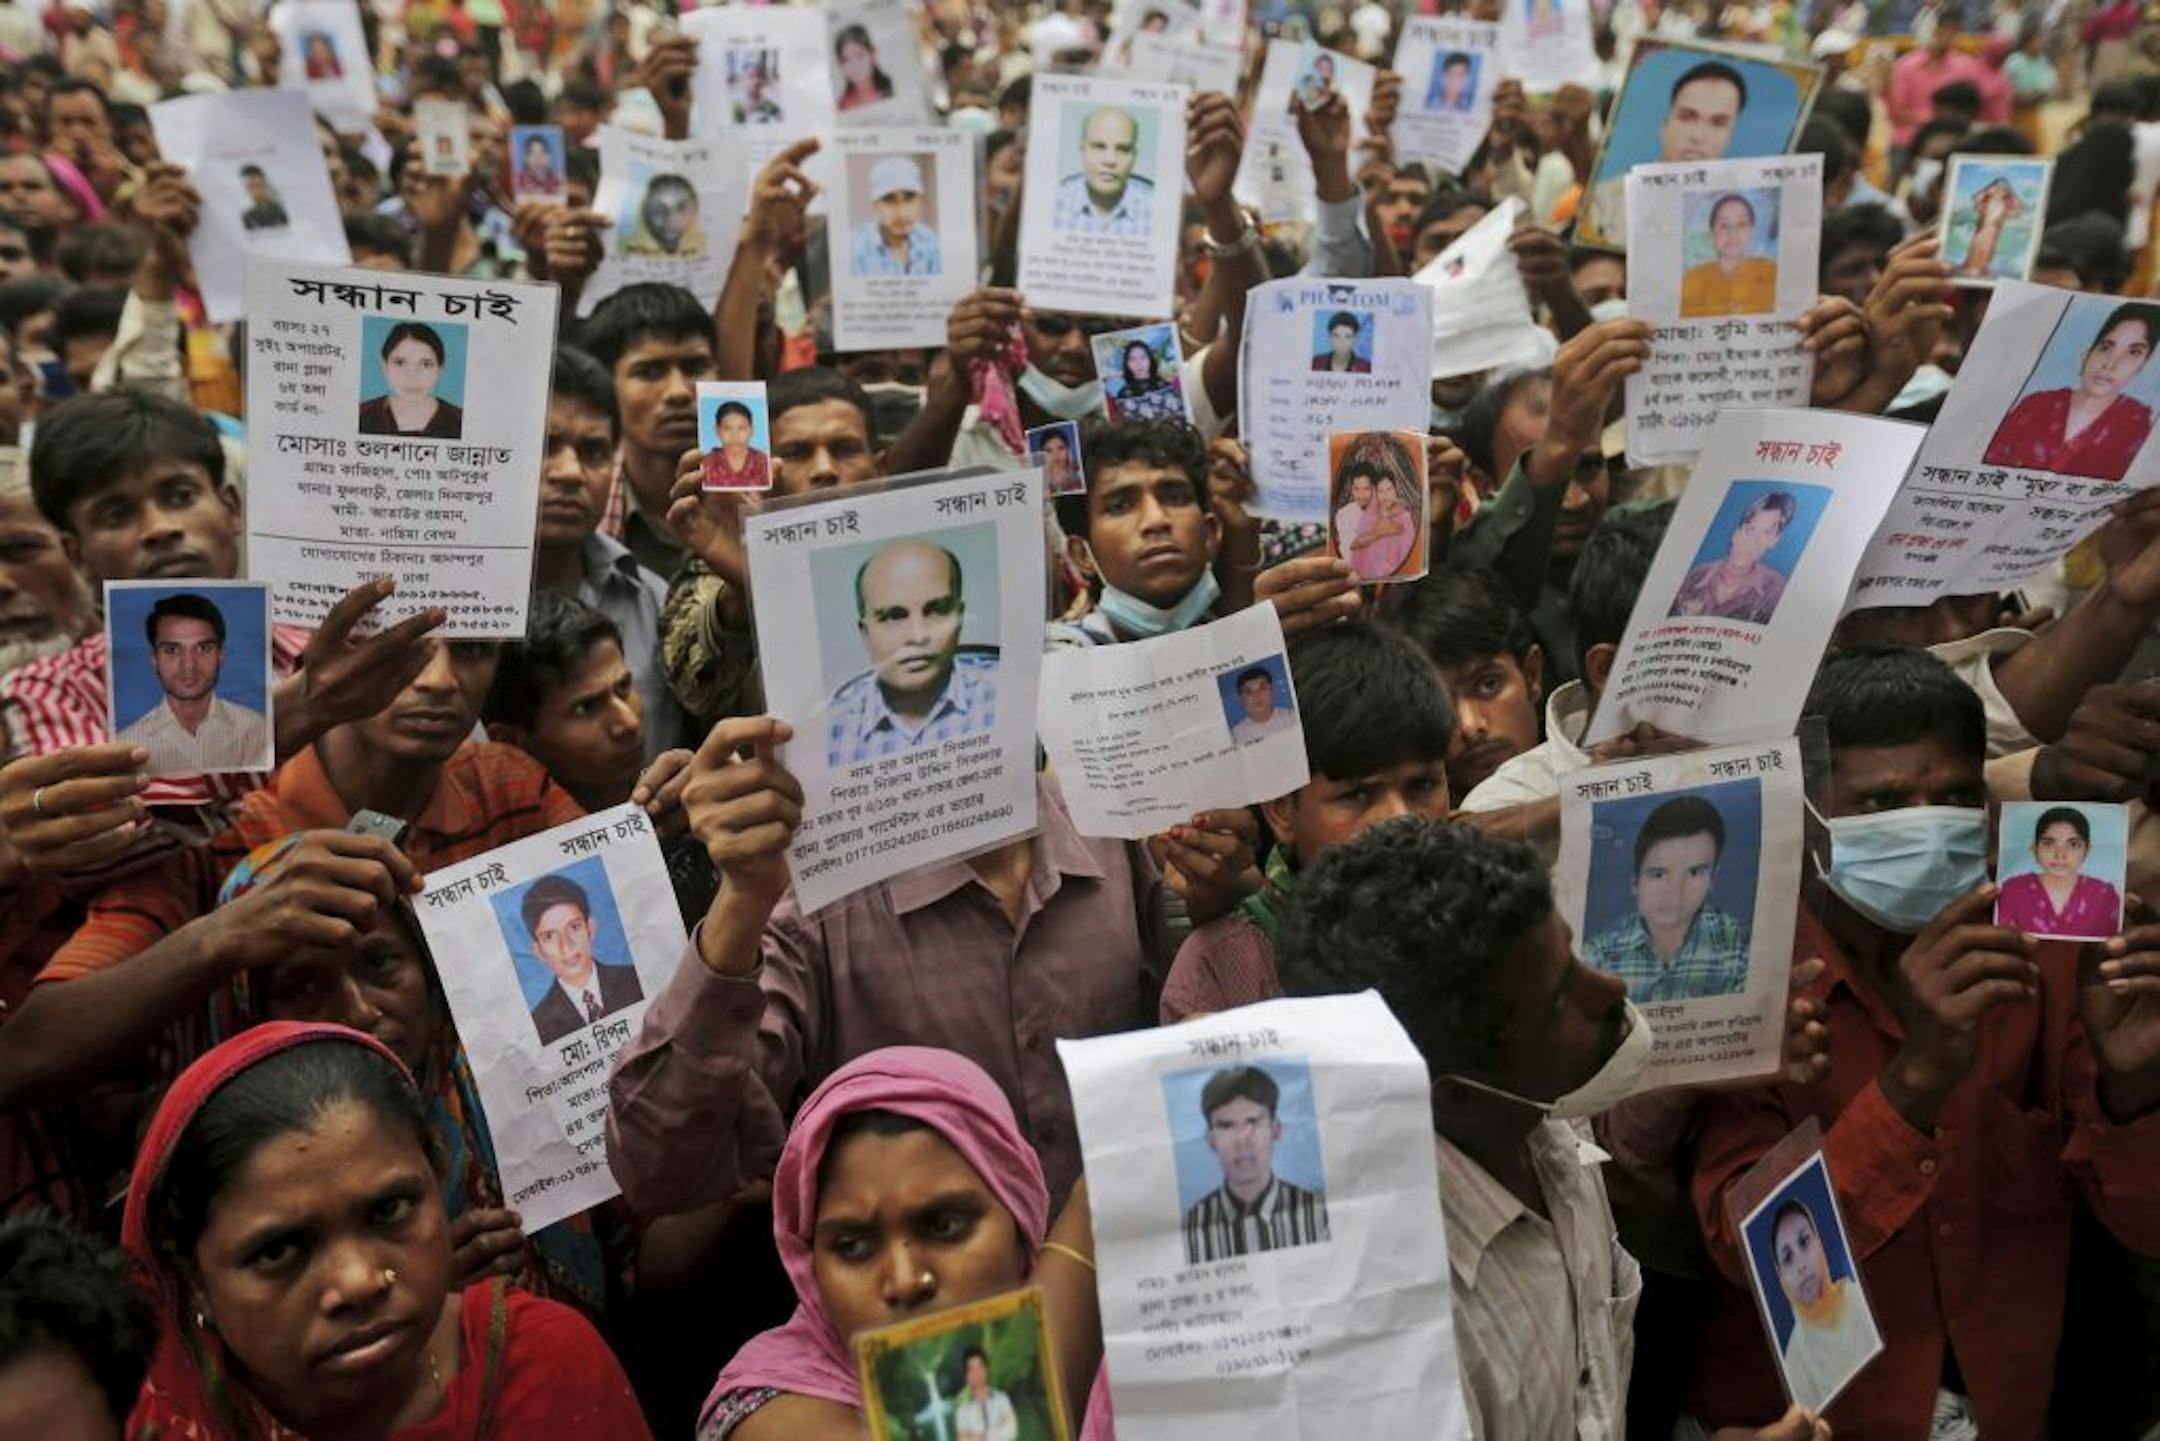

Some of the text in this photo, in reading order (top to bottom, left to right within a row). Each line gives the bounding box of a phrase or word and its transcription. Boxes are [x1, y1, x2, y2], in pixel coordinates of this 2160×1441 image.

[287, 277, 523, 325] সন্ধান চাই
[275, 433, 346, 457] মোসাঃ
[446, 444, 514, 469] জান্নাত
[1755, 439, 1844, 469] সন্ধান চাই
[1921, 464, 1970, 485] সন্ধান
[1975, 469, 2008, 491] চাই
[934, 482, 1029, 517] সন্ধান চাই
[423, 527, 457, 542] বেগম
[763, 509, 863, 547] সন্ধান চাই
[1709, 749, 1787, 778] সন্ধান চাই
[1576, 771, 1654, 802] সন্ধান চাই
[559, 813, 650, 857] সন্ধান চাই
[424, 863, 513, 909] সন্ধান চাই
[559, 1037, 590, 1067] মো:
[591, 1018, 632, 1050] রিপন
[1189, 1035, 1241, 1059] সন্ধান
